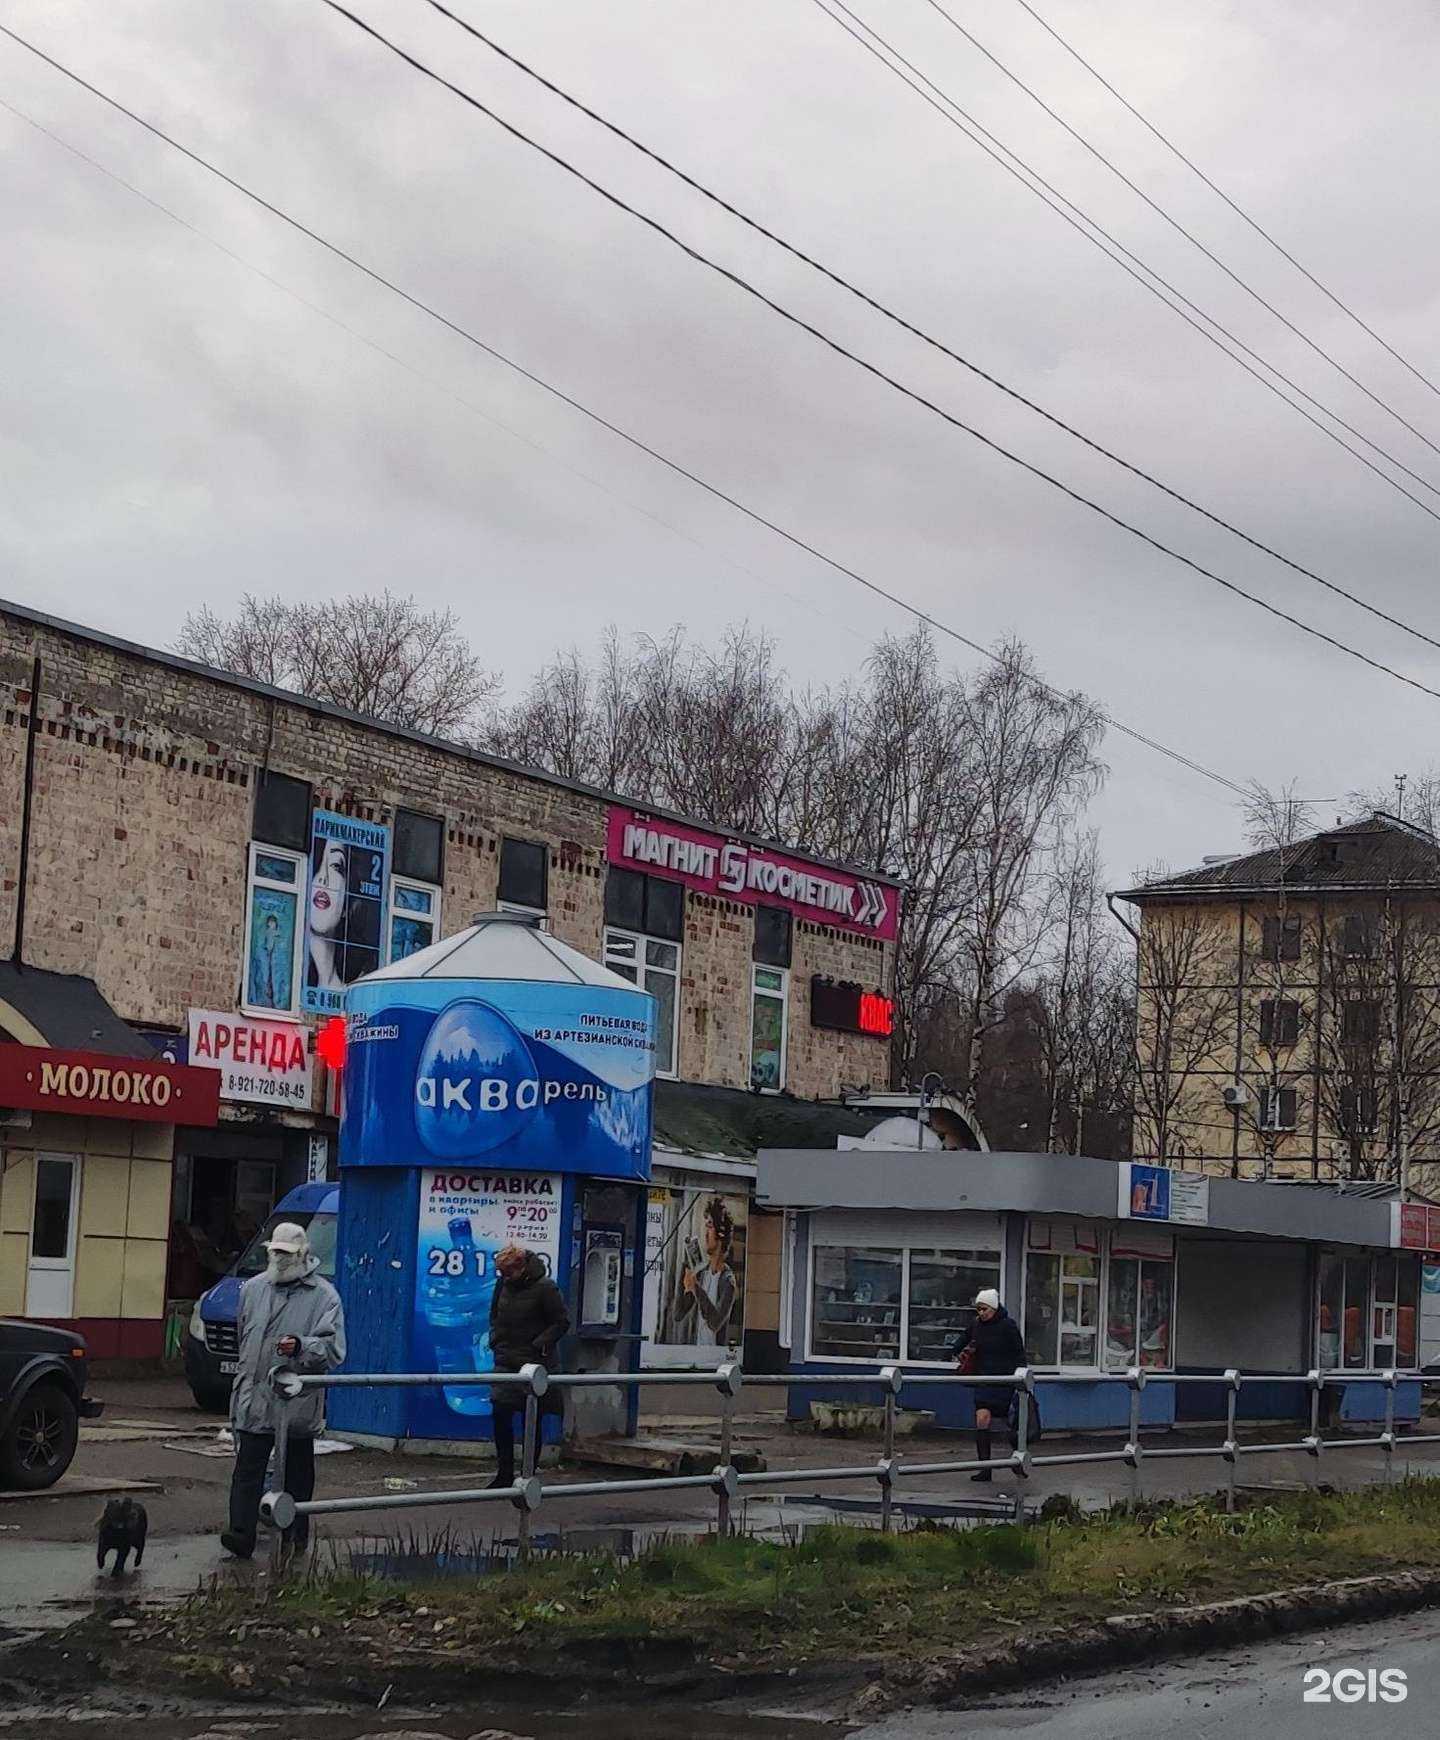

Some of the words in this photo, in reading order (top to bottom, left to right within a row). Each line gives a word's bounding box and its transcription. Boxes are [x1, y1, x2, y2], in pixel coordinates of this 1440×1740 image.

[371, 854, 381, 881] 2
[623, 823, 719, 879] МАГНИТ
[746, 857, 856, 917] КОСМЕТИК
[580, 1013, 631, 1030] ПИТЬЕВАЯ
[195, 1021, 306, 1074] АРЕНДА
[534, 1028, 552, 1041] ИЗ
[554, 1029, 634, 1049] АРТЕЗИАНСКОЙ
[39, 1062, 171, 1106] МОЛОКО
[229, 1074, 305, 1099] 8-921-720-58-45
[431, 1174, 553, 1195] ДОСТАВКА
[428, 1249, 464, 1277] 28
